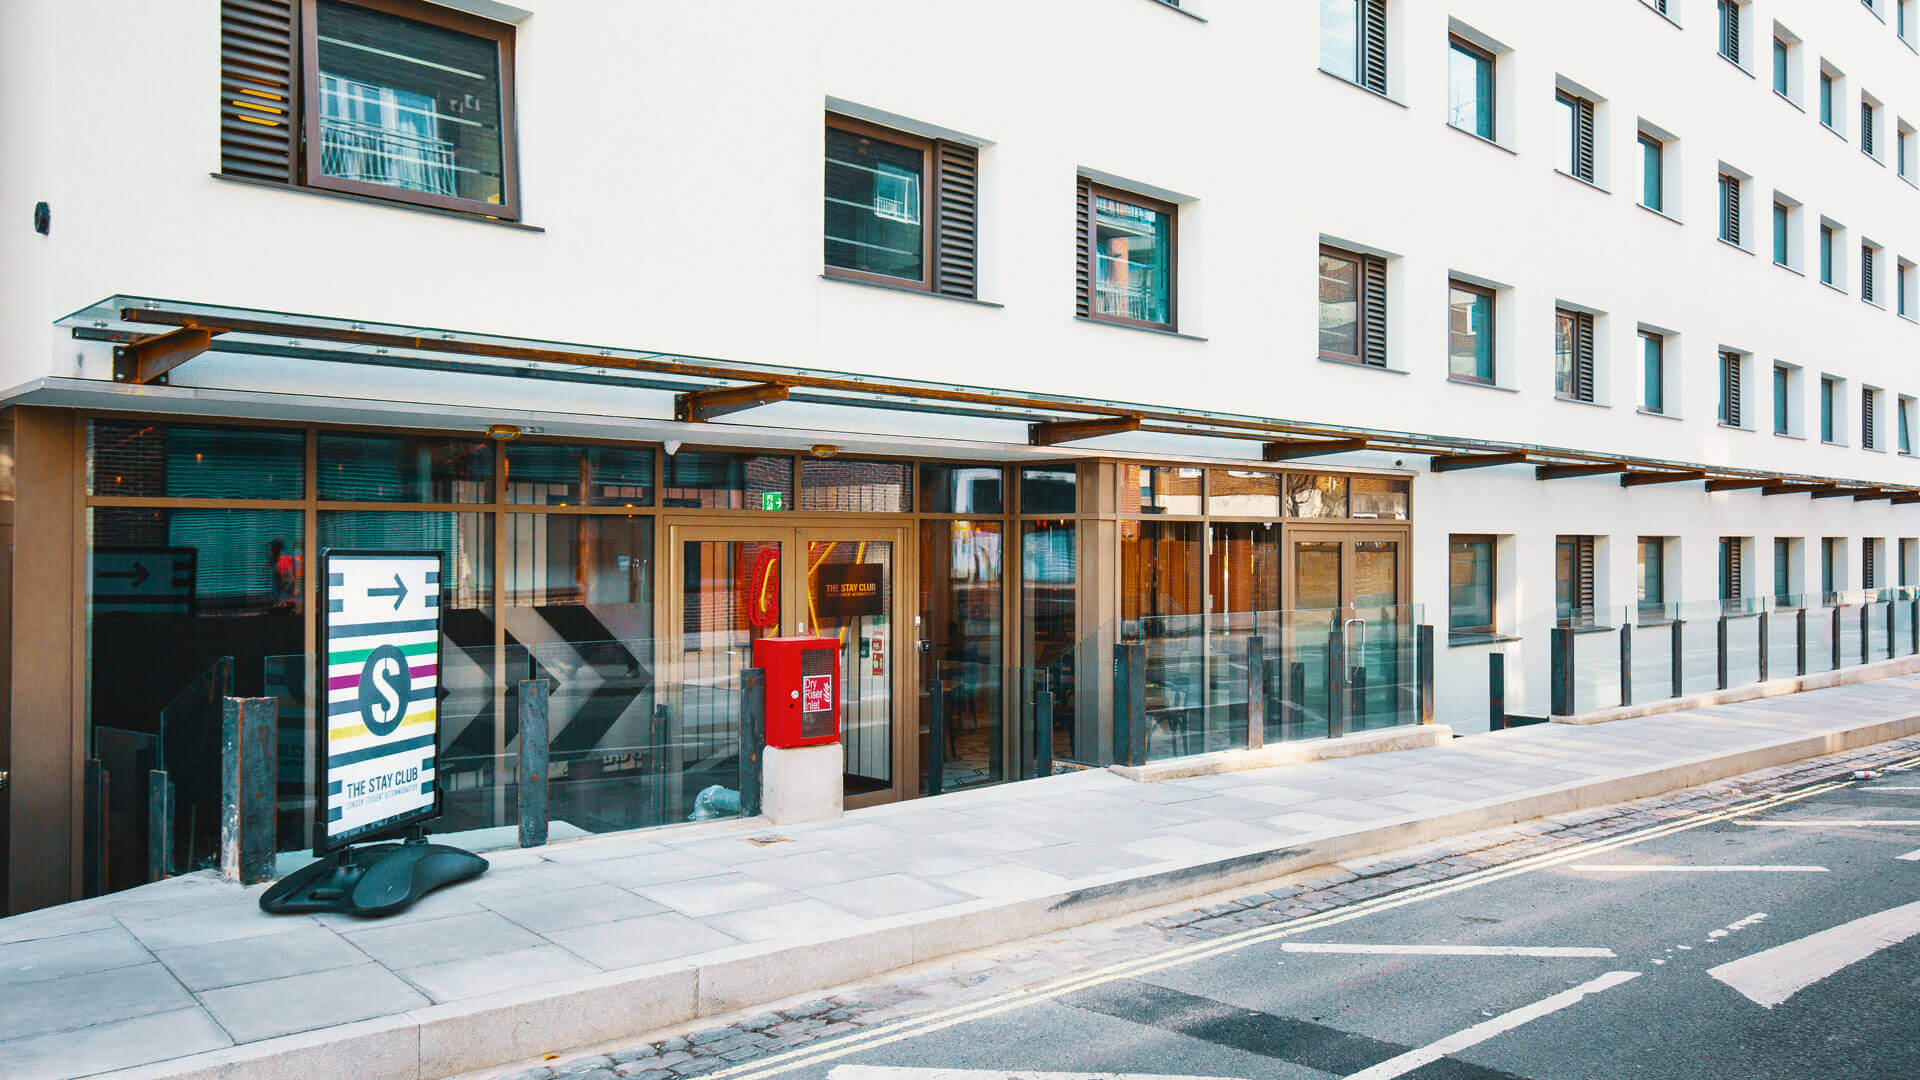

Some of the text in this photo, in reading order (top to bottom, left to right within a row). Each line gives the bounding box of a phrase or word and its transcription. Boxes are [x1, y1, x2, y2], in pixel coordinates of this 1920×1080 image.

[825, 583, 876, 593] THE STAY CLUB
[805, 678, 817, 690] Dry
[371, 657, 400, 724] S
[805, 689, 822, 700] Riser
[347, 766, 418, 799] THE STAY CLUB
